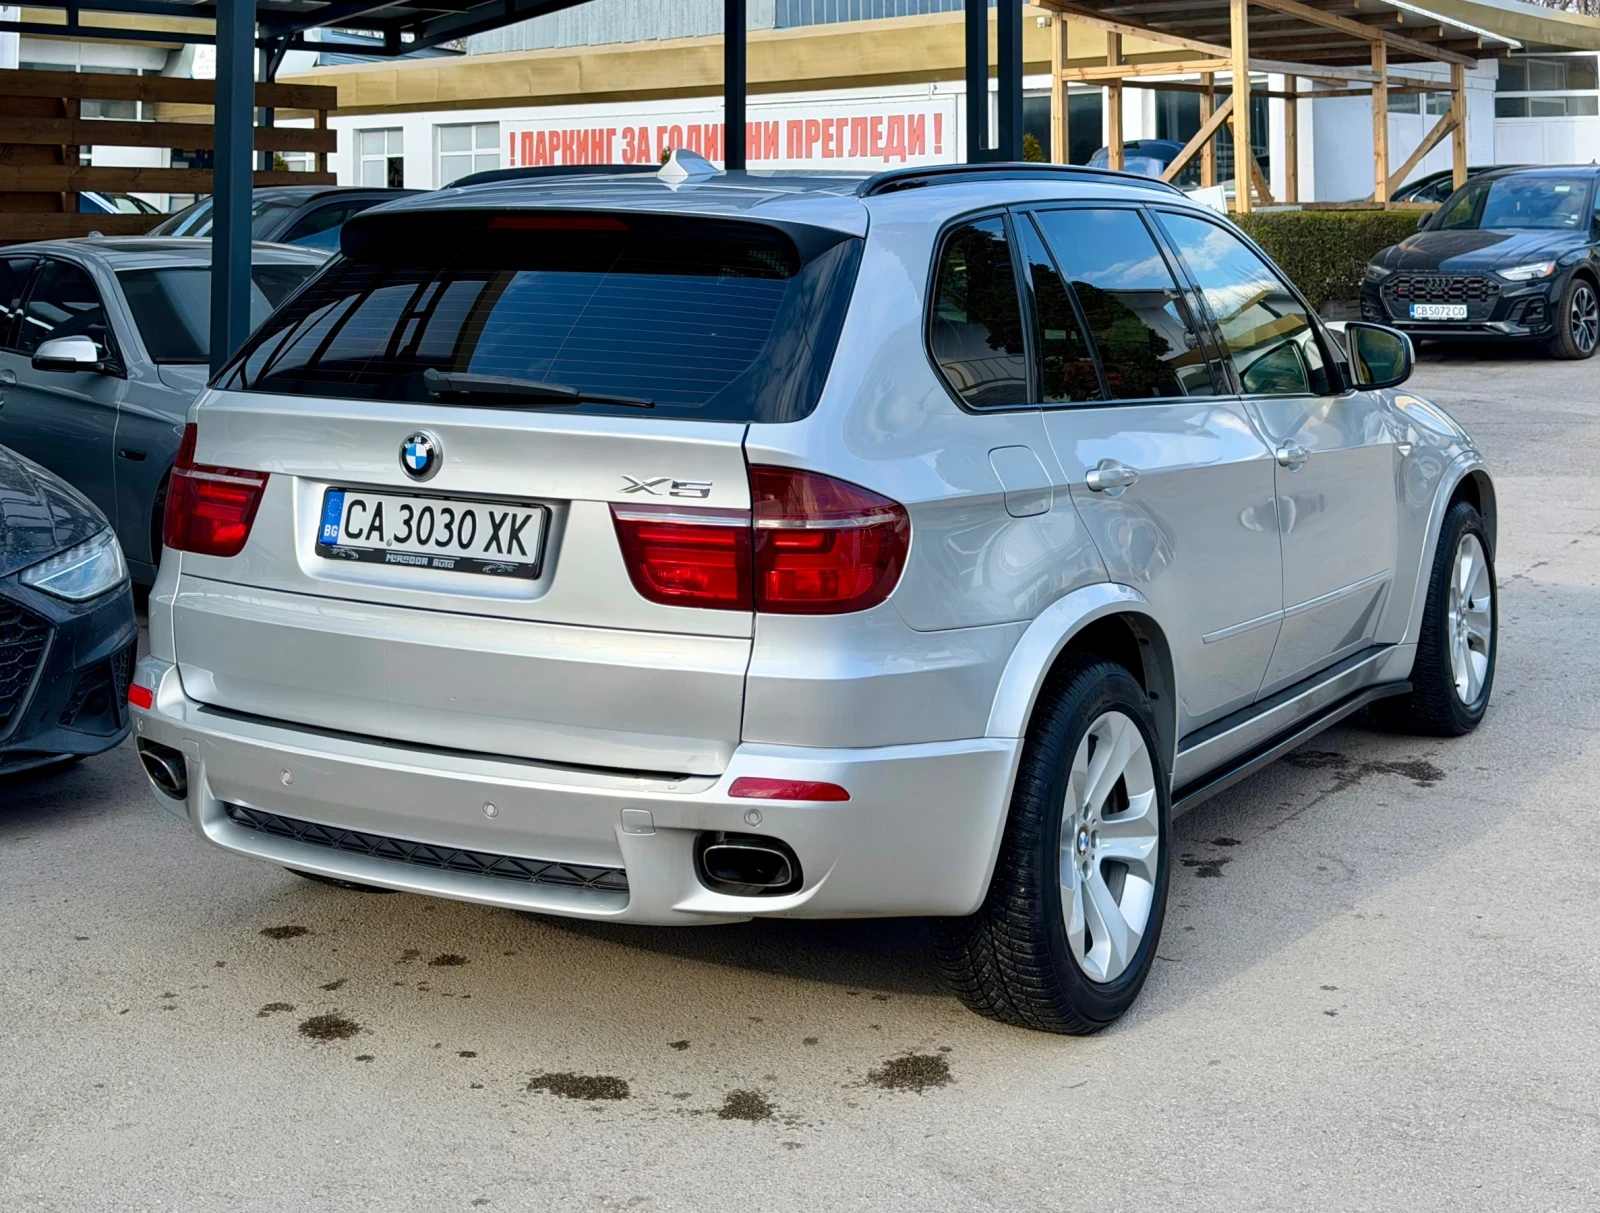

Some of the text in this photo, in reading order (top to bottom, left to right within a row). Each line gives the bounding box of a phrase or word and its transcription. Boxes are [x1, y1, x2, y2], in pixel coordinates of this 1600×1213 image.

[509, 112, 943, 167] ! ПАРКИНГ ЗА ГОДИНИ ПРЕГЛЕДИ !
[1416, 306, 1465, 316] CB 5072 CO
[616, 474, 713, 498] X5
[323, 524, 338, 537] BG
[344, 499, 533, 557] CA 3030 XK
